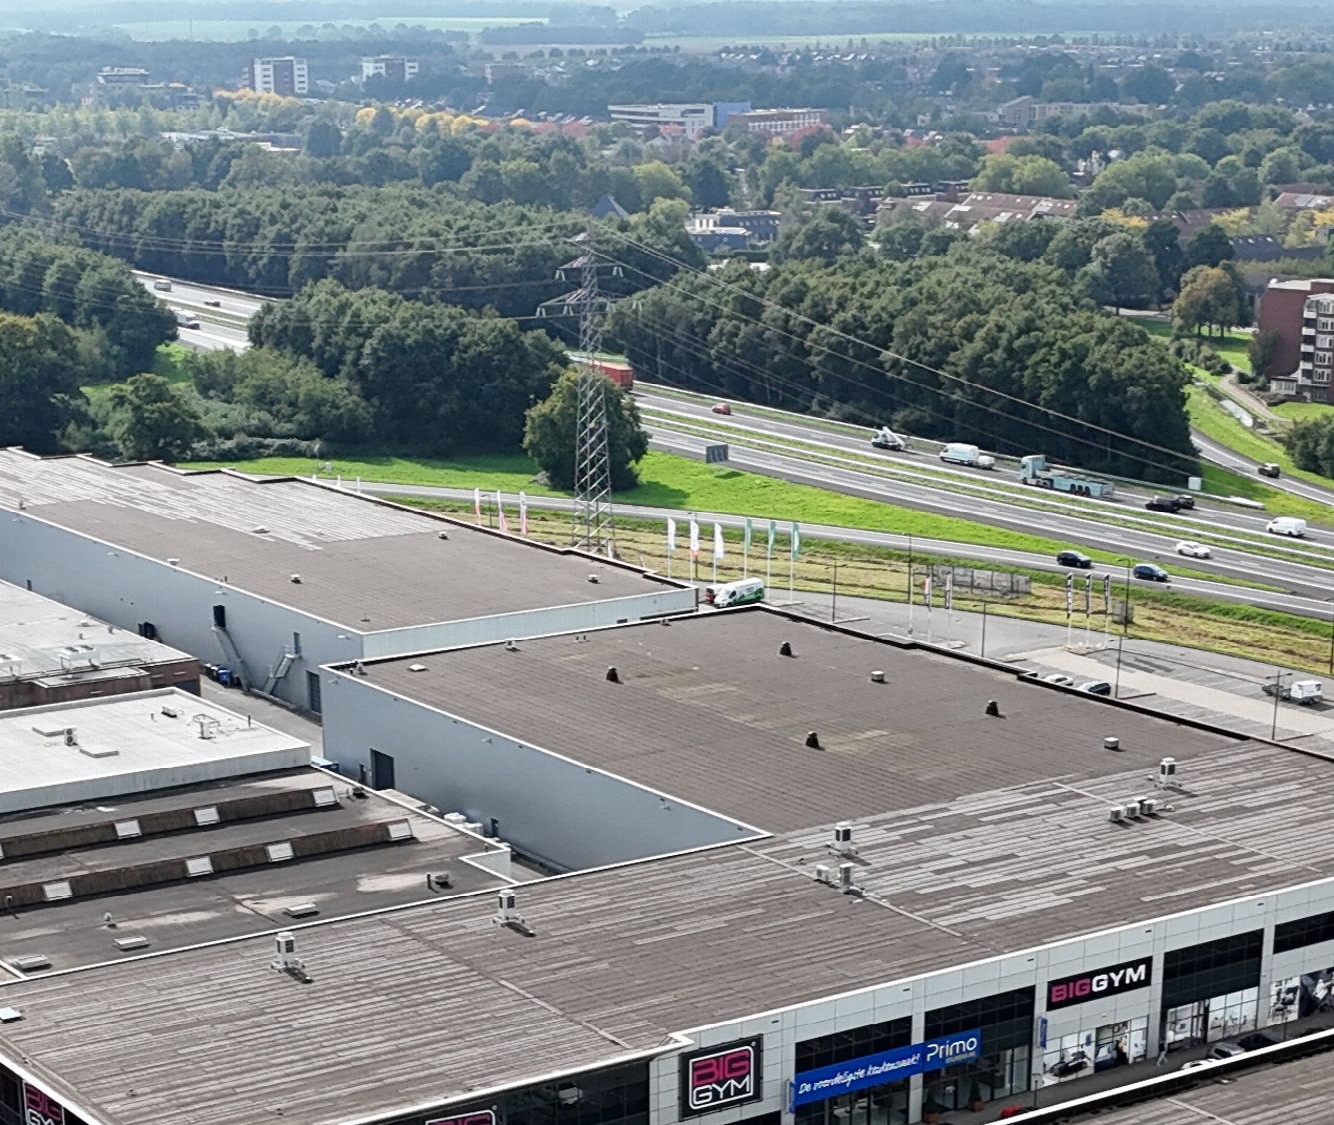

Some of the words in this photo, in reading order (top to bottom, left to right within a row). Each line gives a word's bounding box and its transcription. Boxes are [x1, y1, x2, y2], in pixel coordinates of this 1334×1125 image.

[926, 1036, 978, 1062] Primo
[693, 1049, 750, 1088] BIG
[693, 1074, 750, 1105] GYM
